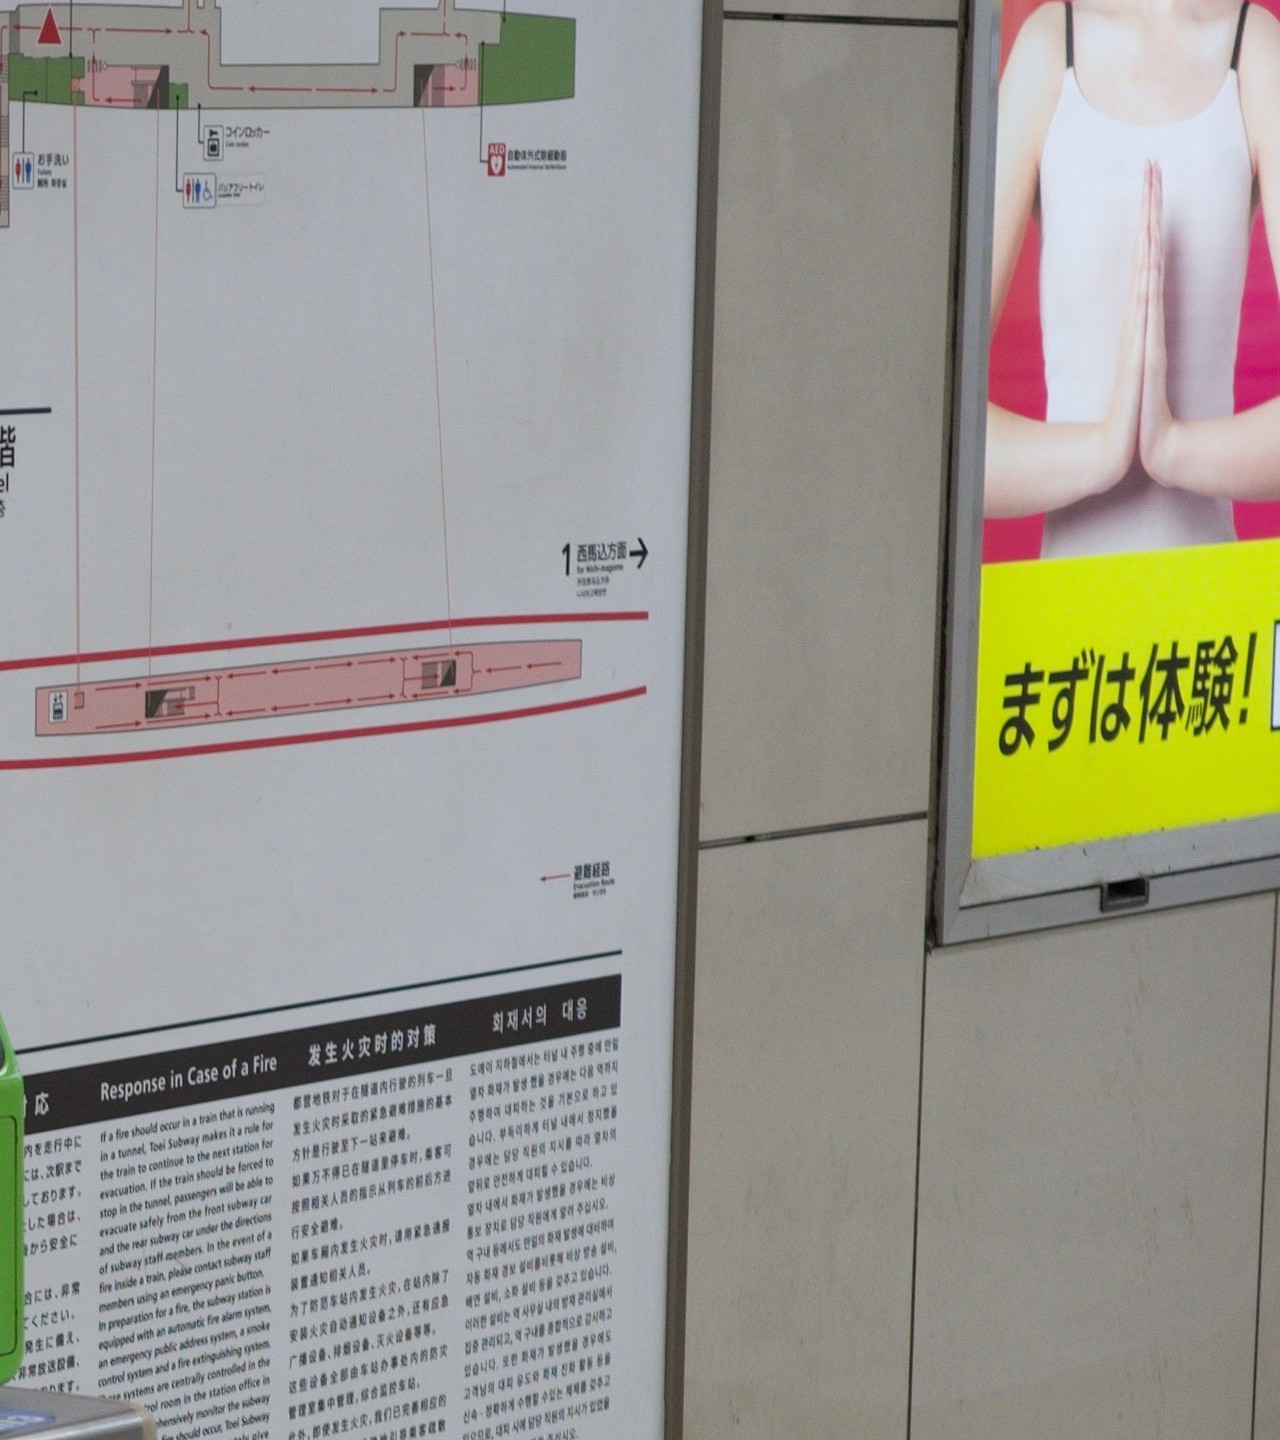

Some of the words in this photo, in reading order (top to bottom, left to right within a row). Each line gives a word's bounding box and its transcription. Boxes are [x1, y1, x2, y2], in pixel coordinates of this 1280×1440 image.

[561, 543, 570, 576] 1
[562, 997, 588, 1022] 대응
[308, 1023, 437, 1068] 发生火灾时的对策
[100, 1076, 166, 1103] Response
[170, 1069, 183, 1089] in
[187, 1065, 219, 1086] Case
[223, 1058, 238, 1079] of
[241, 1062, 249, 1076] a
[253, 1053, 278, 1074] Fire
[100, 1131, 107, 1143] If
[109, 1133, 114, 1143] a
[116, 1129, 130, 1140] fire
[131, 1122, 159, 1138] should
[159, 1121, 181, 1133] occur
[183, 1118, 191, 1128] in
[192, 1118, 198, 1127] a
[199, 1112, 218, 1125] train
[219, 1110, 236, 1122] that
[237, 1109, 244, 1118] is
[245, 1103, 276, 1117] running
[100, 1151, 109, 1163] in
[111, 1151, 116, 1161] a
[118, 1144, 148, 1159] tunnel,
[150, 1142, 167, 1153] Toei
[168, 1136, 200, 1150] Subway
[202, 1130, 228, 1143] makes
[229, 1127, 236, 1138] it
[237, 1128, 243, 1137] a
[244, 1123, 260, 1135] rule
[262, 1121, 274, 1132] for
[100, 1170, 115, 1182] the
[116, 1167, 136, 1178] train
[138, 1164, 148, 1174] to
[149, 1158, 185, 1172] continue
[186, 1155, 196, 1165] to
[197, 1151, 211, 1163] the
[212, 1147, 231, 1160] next
[232, 1143, 260, 1156] station
[262, 1139, 274, 1150] for
[100, 1184, 146, 1200] evacuation.
[150, 1178, 157, 1190] If
[159, 1177, 173, 1189] the
[175, 1174, 195, 1186] train
[197, 1166, 224, 1181] should
[226, 1165, 236, 1176] be
[238, 1158, 264, 1173] forced
[265, 1158, 275, 1168] to
